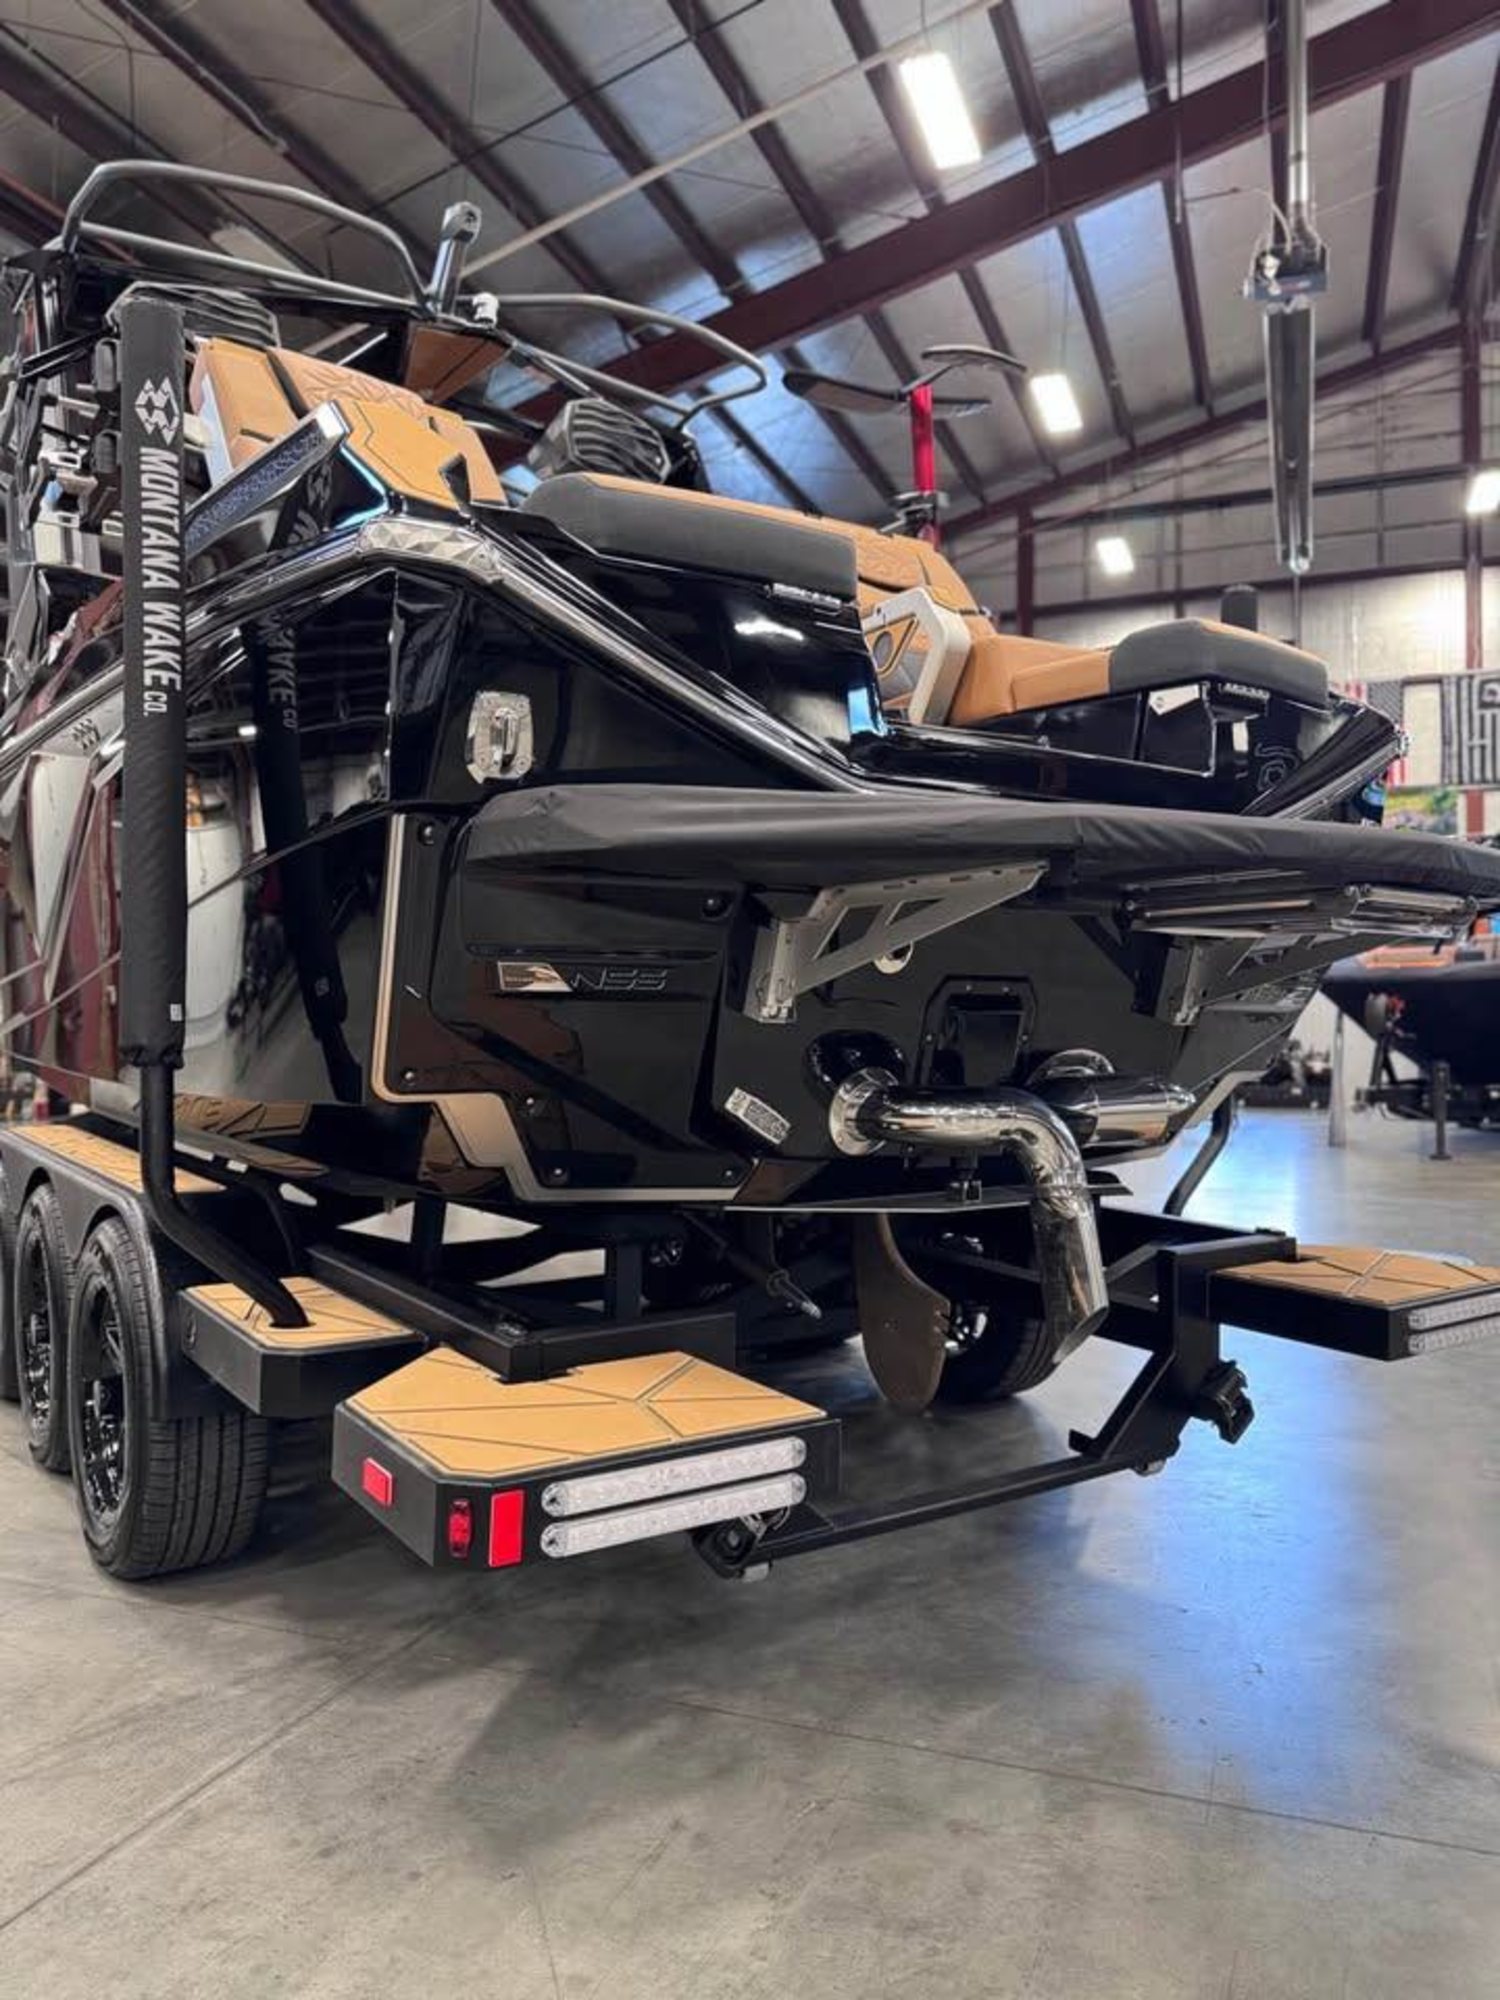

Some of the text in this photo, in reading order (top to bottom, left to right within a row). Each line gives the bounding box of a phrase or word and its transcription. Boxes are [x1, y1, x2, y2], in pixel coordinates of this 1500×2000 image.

[140, 446, 182, 716] MONTANA WAKE CO.
